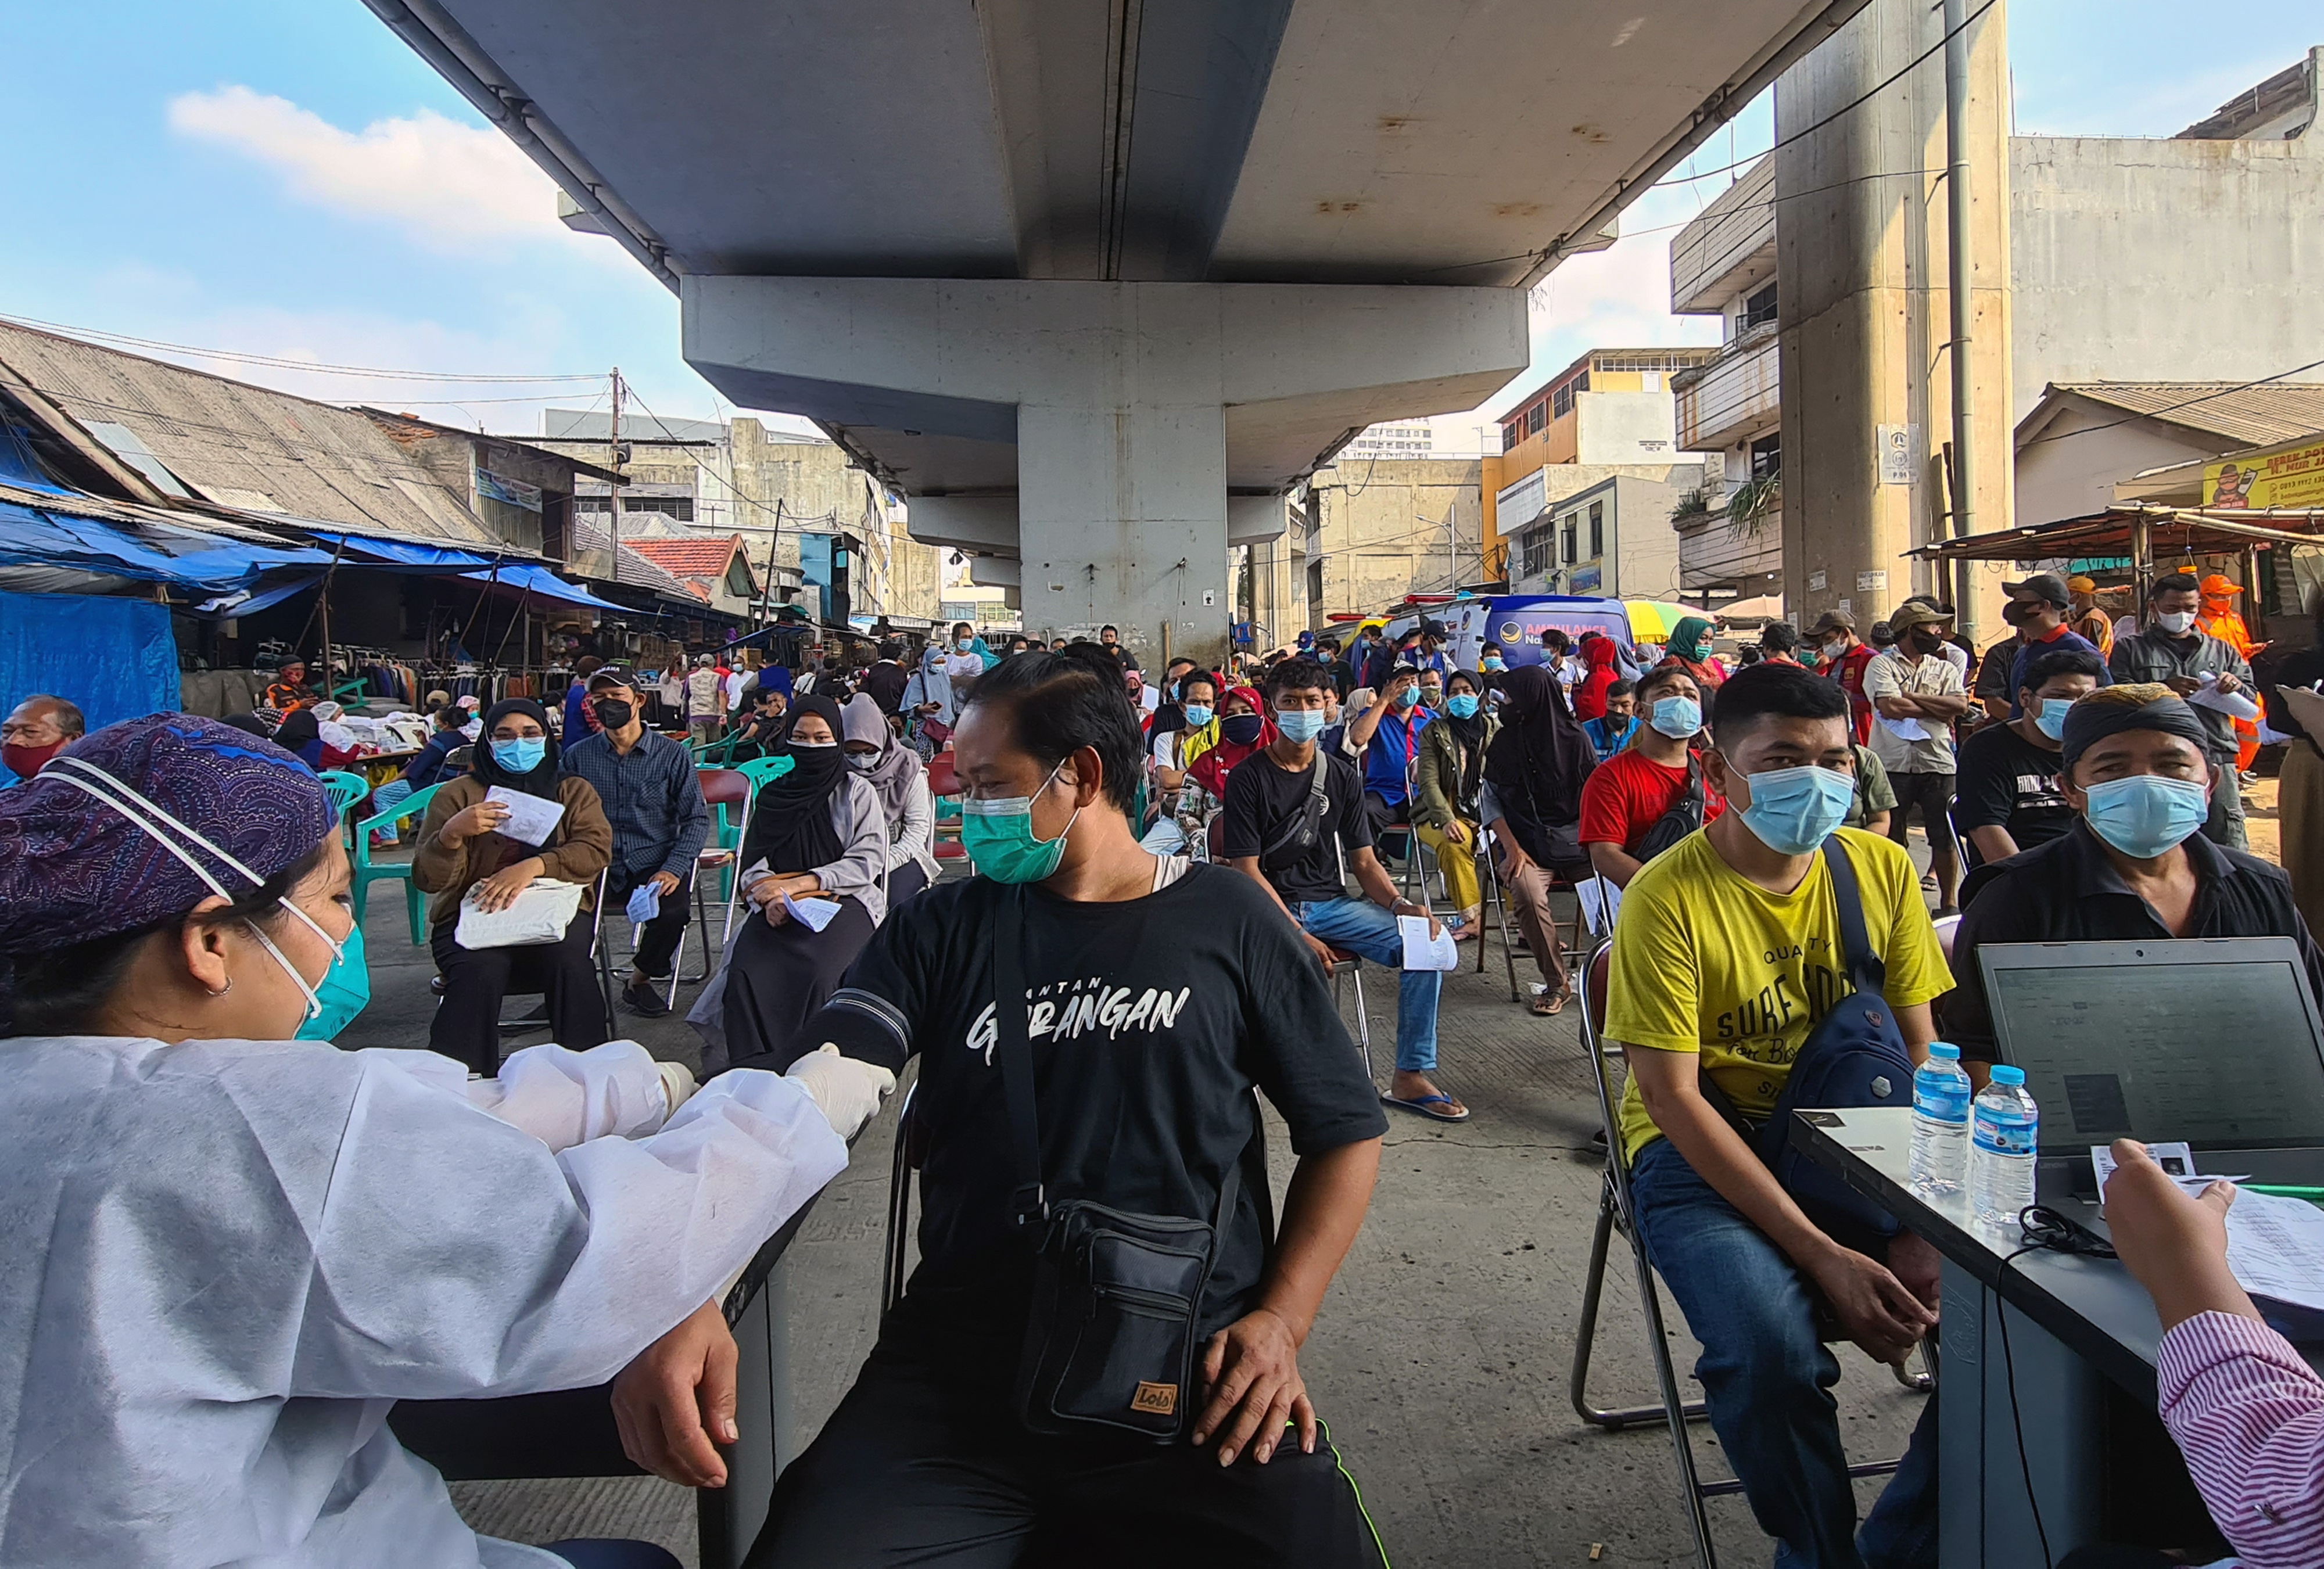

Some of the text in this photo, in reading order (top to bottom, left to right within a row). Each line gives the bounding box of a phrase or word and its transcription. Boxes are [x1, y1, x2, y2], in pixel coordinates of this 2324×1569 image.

[595, 666, 620, 674] MAHA
[966, 985, 1190, 1066] GRANGAN
[1138, 1388, 1169, 1407] Lois
